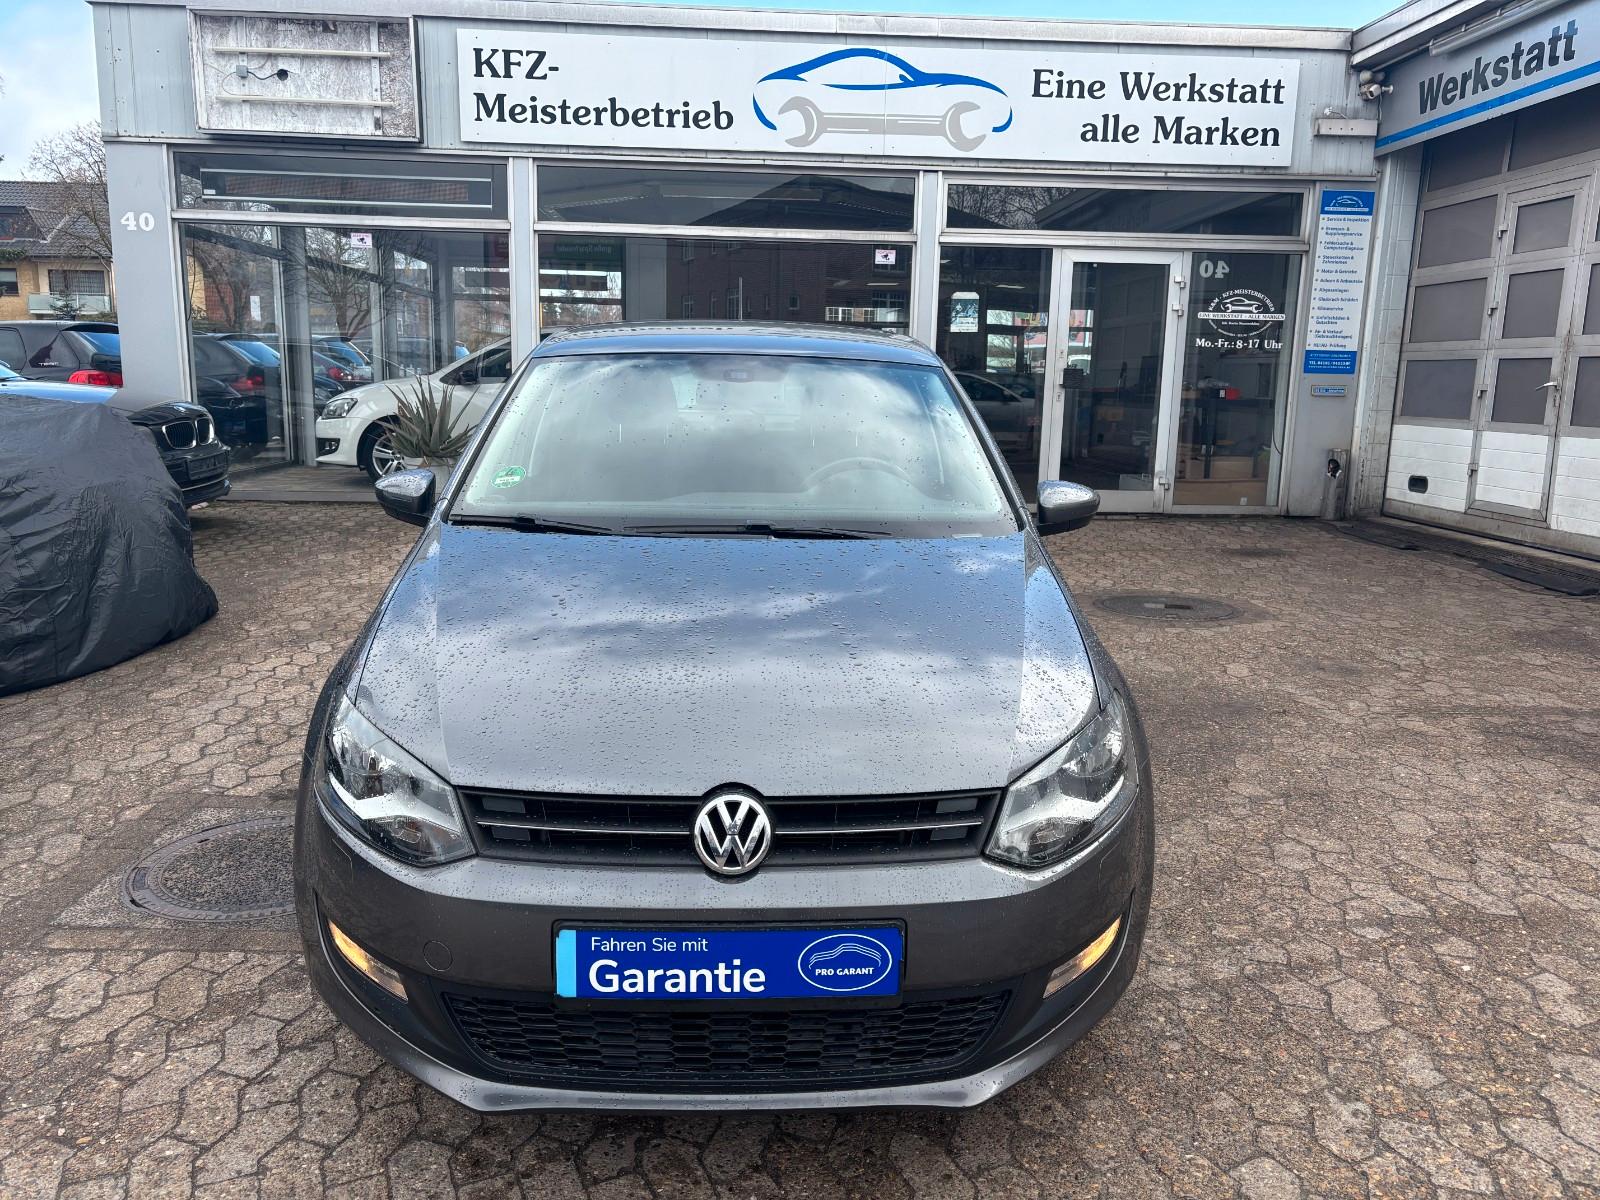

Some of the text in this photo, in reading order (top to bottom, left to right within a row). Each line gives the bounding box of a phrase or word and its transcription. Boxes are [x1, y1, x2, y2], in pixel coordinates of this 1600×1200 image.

[472, 48, 559, 80] KFZ-
[1419, 19, 1578, 114] Werkstatt
[1032, 68, 1285, 104] Eine Werkstatt
[473, 92, 734, 130] Meisterbetrieb
[1080, 114, 1280, 146] alle Marken
[120, 211, 154, 231] 40
[1264, 340, 1284, 349] Uhr
[591, 937, 708, 952] Fahren Sie mit
[589, 958, 766, 994] Garantie
[815, 967, 874, 976] PRO GARANT
